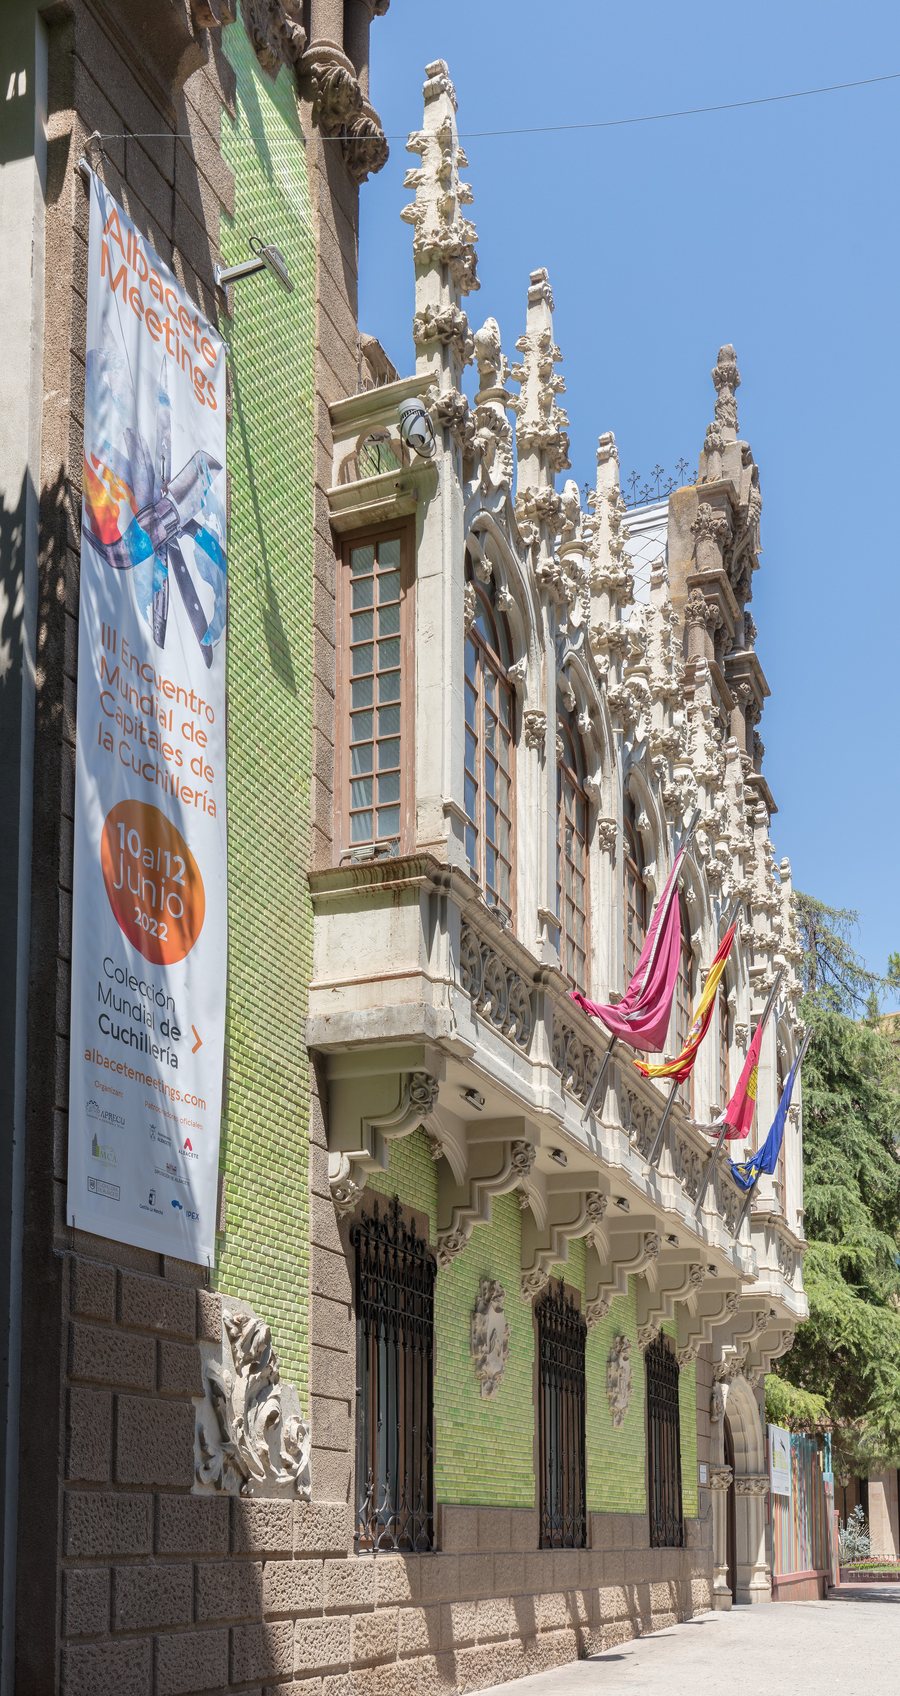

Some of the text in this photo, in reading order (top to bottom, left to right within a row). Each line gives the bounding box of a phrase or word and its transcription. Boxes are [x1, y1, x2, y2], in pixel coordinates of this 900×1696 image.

[103, 207, 217, 368] Albacete
[100, 240, 218, 411] Meetings
[100, 655, 208, 748] Mundial de
[101, 622, 215, 724] III Encuentro
[100, 690, 215, 783] Capitales de
[97, 722, 217, 817] la Cuchillería
[113, 853, 184, 919] Junio
[116, 822, 187, 887] 10 al 12
[134, 906, 169, 942] 2022
[97, 981, 181, 1041] Mundial de
[103, 957, 176, 1013] Colección
[99, 1013, 179, 1069] Cuchillería
[84, 1048, 207, 1110] albacetemeetings.com
[178, 1149, 199, 1160] ALBACETE
[186, 1210, 200, 1221] IPEX
